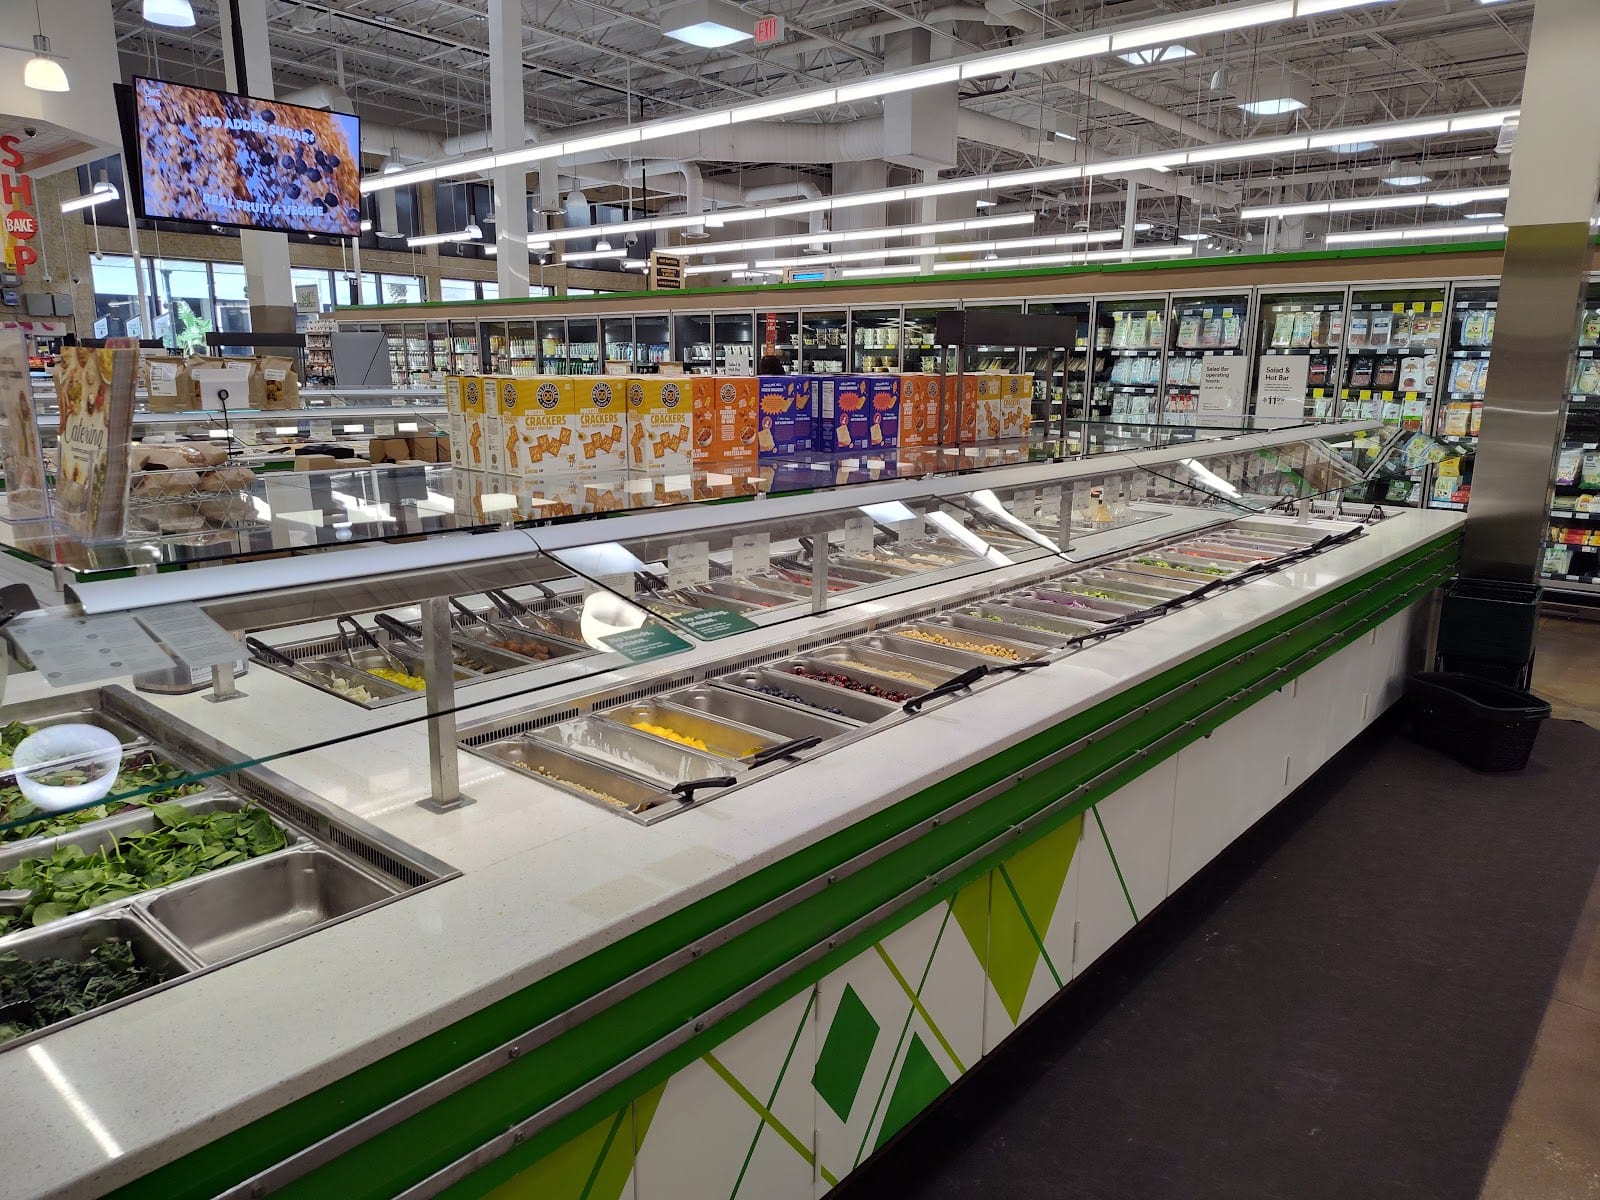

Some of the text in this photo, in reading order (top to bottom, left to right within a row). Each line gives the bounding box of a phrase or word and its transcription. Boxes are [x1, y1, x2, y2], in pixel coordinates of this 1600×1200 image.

[758, 17, 777, 42] EXIT
[200, 116, 223, 129] NO
[224, 118, 267, 134] ADDED
[202, 192, 324, 217] REAL FRUIT & VEGGIE
[6, 218, 34, 233] BAKE
[525, 415, 567, 426] CRACKERS
[580, 414, 618, 425] CRACKERS
[650, 414, 686, 424] CRACKERS
[65, 412, 104, 449] Catering
